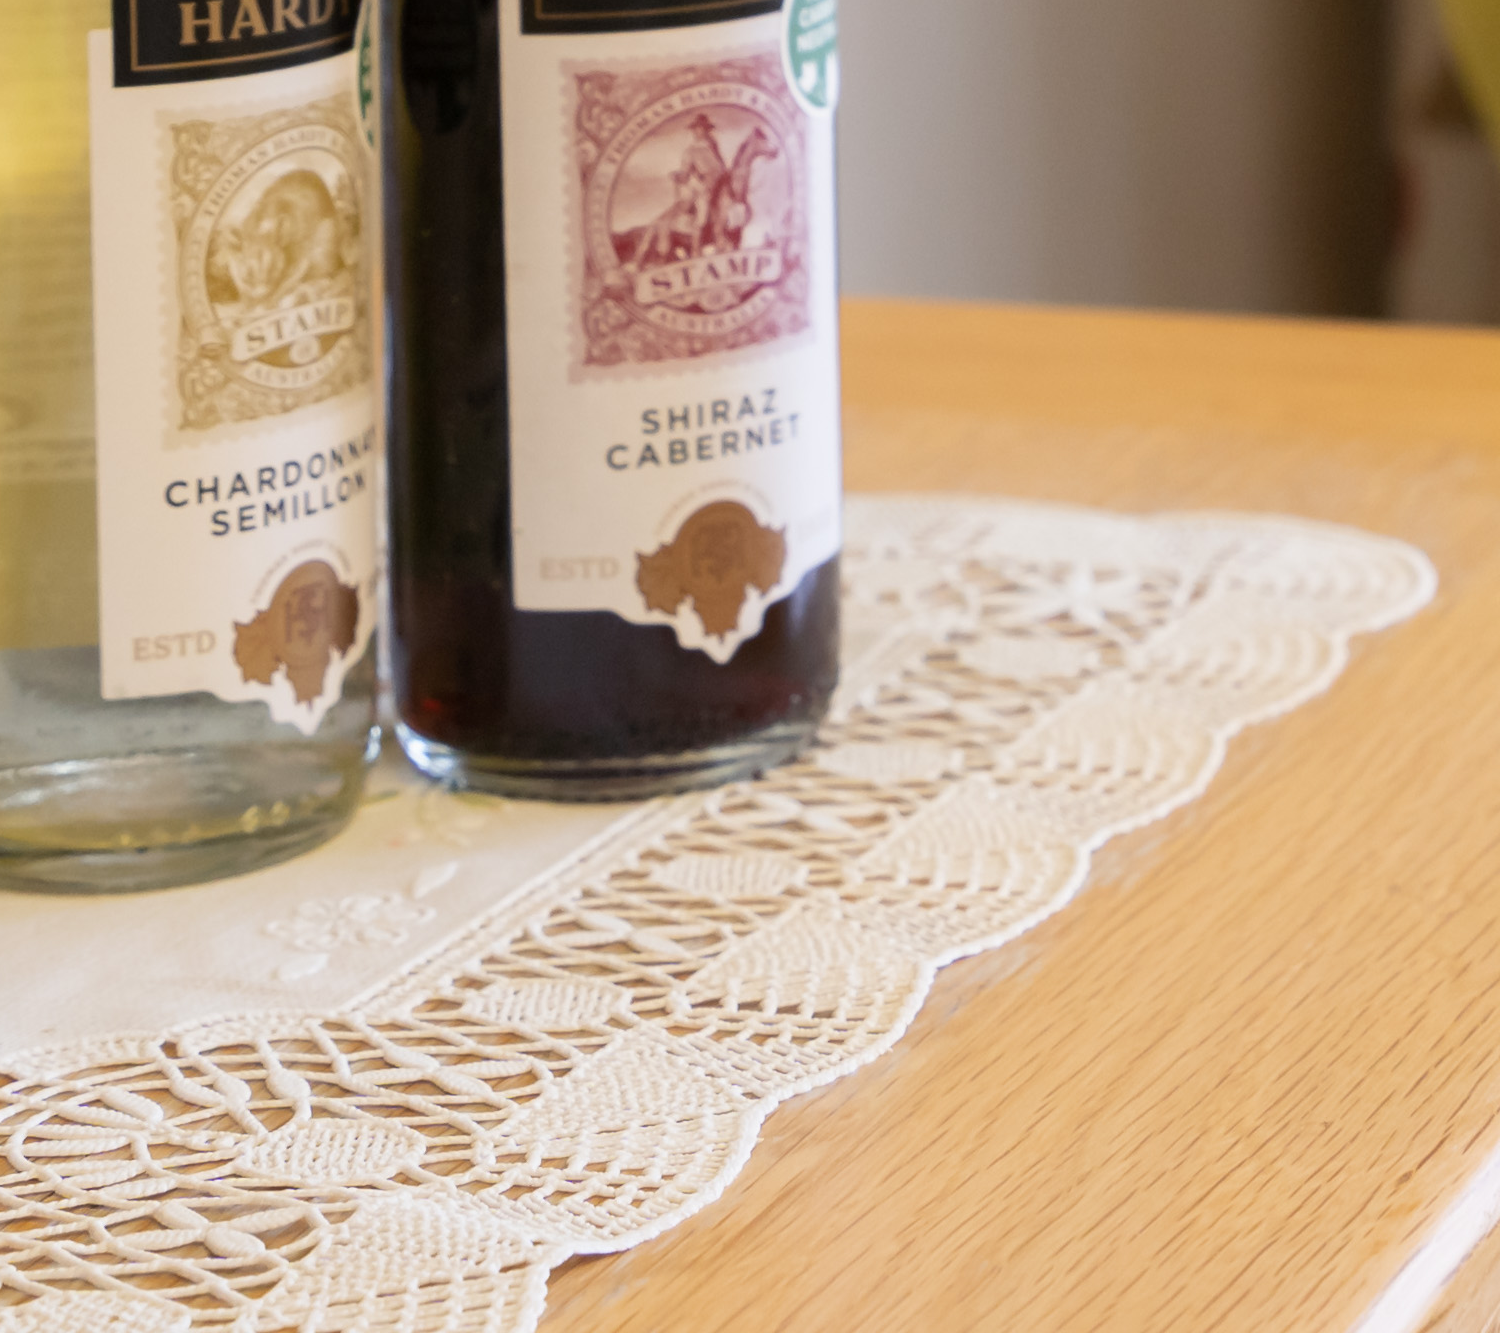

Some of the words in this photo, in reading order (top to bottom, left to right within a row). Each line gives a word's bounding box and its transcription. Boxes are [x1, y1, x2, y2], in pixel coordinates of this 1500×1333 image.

[650, 254, 773, 293] STAMP
[245, 300, 350, 353] STAMP
[640, 388, 777, 436] SHIRAZ
[606, 414, 800, 471] CABERNET
[211, 471, 366, 536] SEMILLON
[539, 556, 621, 581] ESTD
[132, 629, 217, 662] ESTD
